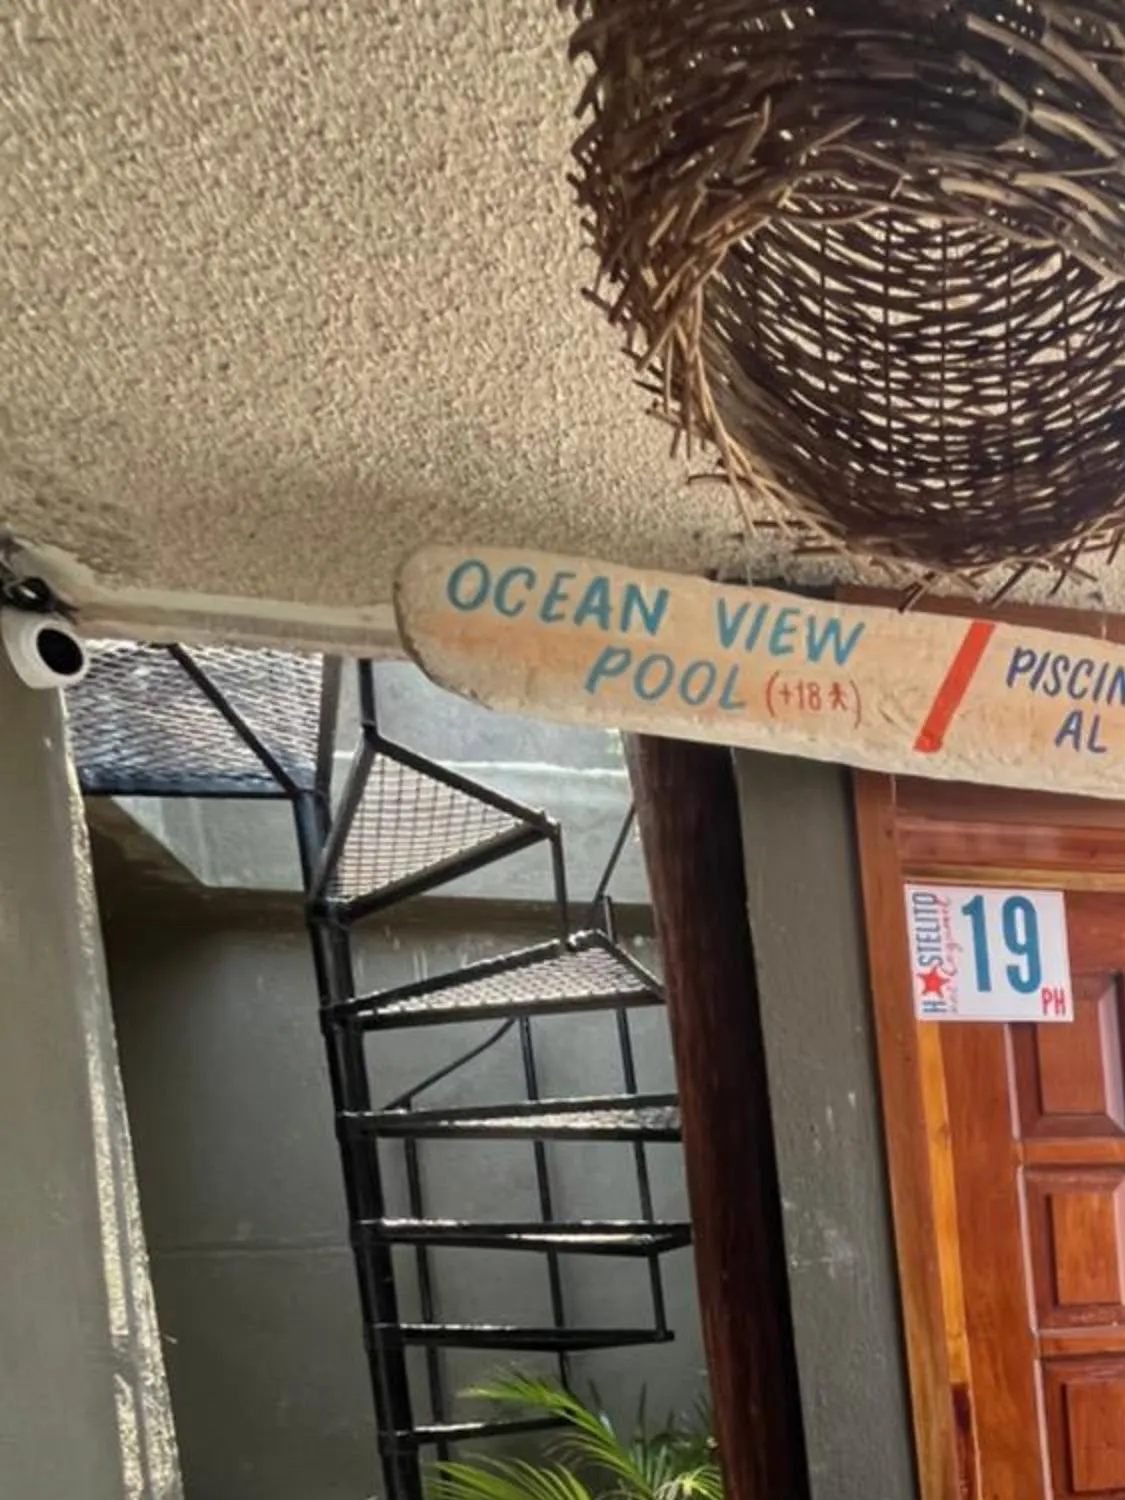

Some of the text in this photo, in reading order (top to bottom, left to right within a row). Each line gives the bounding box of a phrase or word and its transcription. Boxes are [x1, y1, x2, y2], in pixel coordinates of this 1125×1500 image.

[447, 559, 867, 666] OCEAN VIEW
[584, 646, 747, 711] POOL
[1055, 709, 1107, 754] AL
[961, 894, 1042, 994] 19
[1041, 987, 1067, 1016] PH
